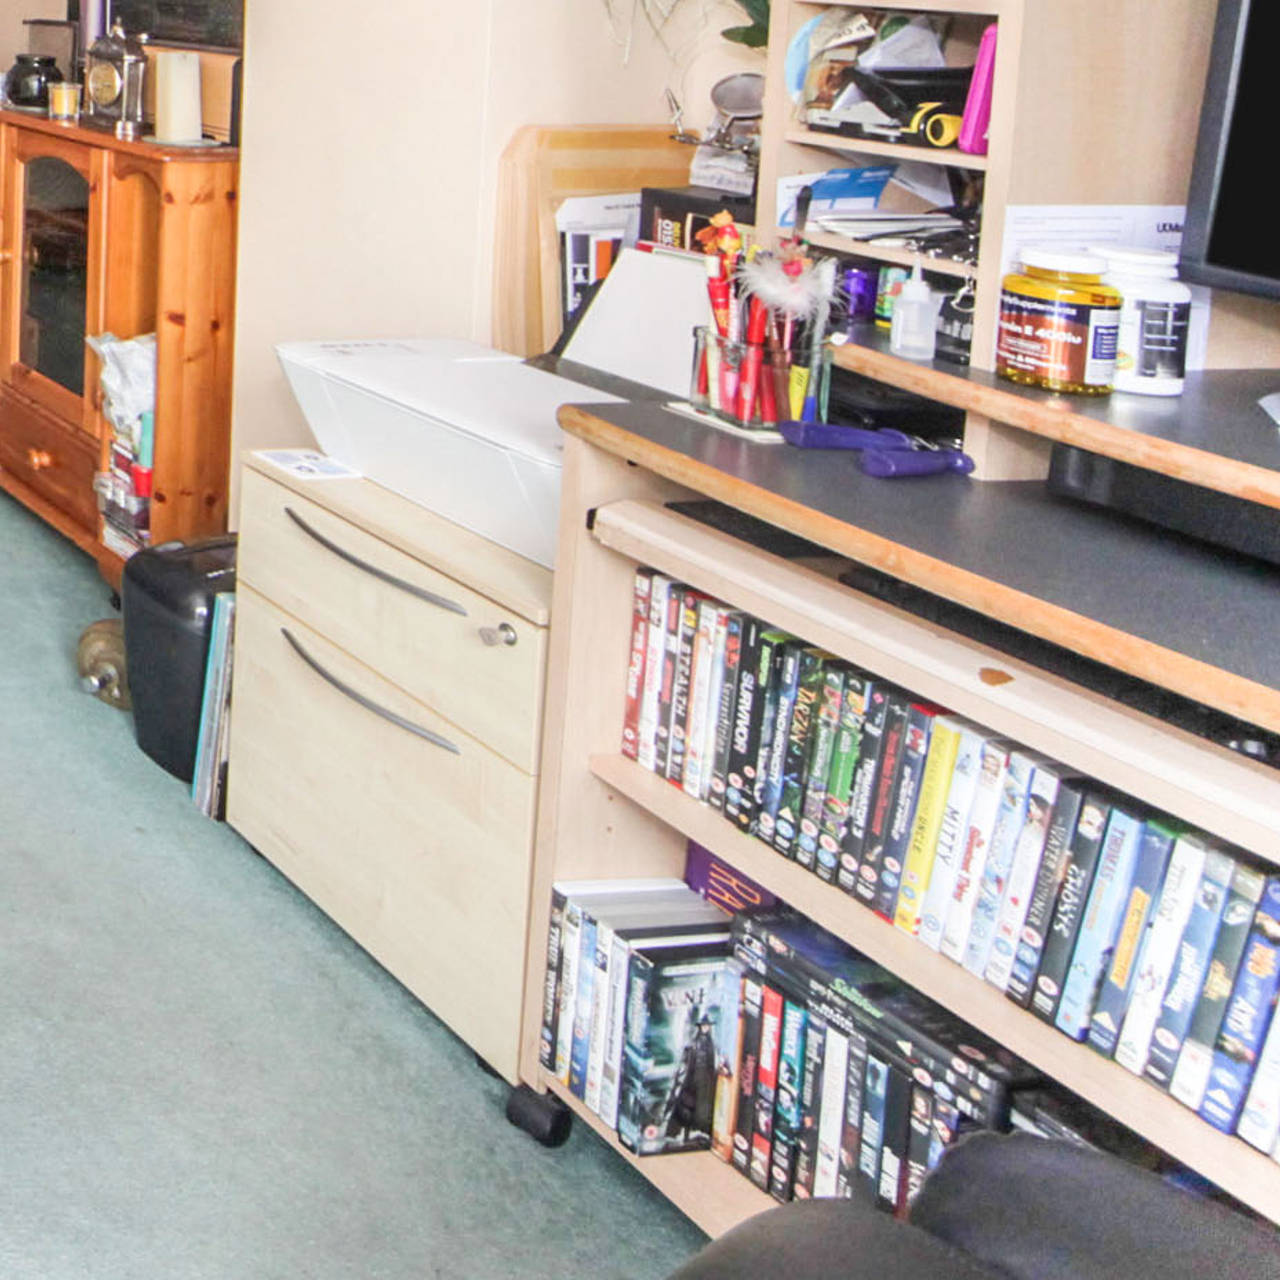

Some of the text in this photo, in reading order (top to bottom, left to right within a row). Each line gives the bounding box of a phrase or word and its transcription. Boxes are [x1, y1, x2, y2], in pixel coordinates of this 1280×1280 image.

[1024, 325, 1034, 336] E
[675, 642, 690, 718] STEALTH
[734, 670, 754, 754] SURVIVOR
[790, 684, 815, 747] TARZAN
[938, 803, 960, 867] MITTY
[1044, 818, 1066, 870] WATER
